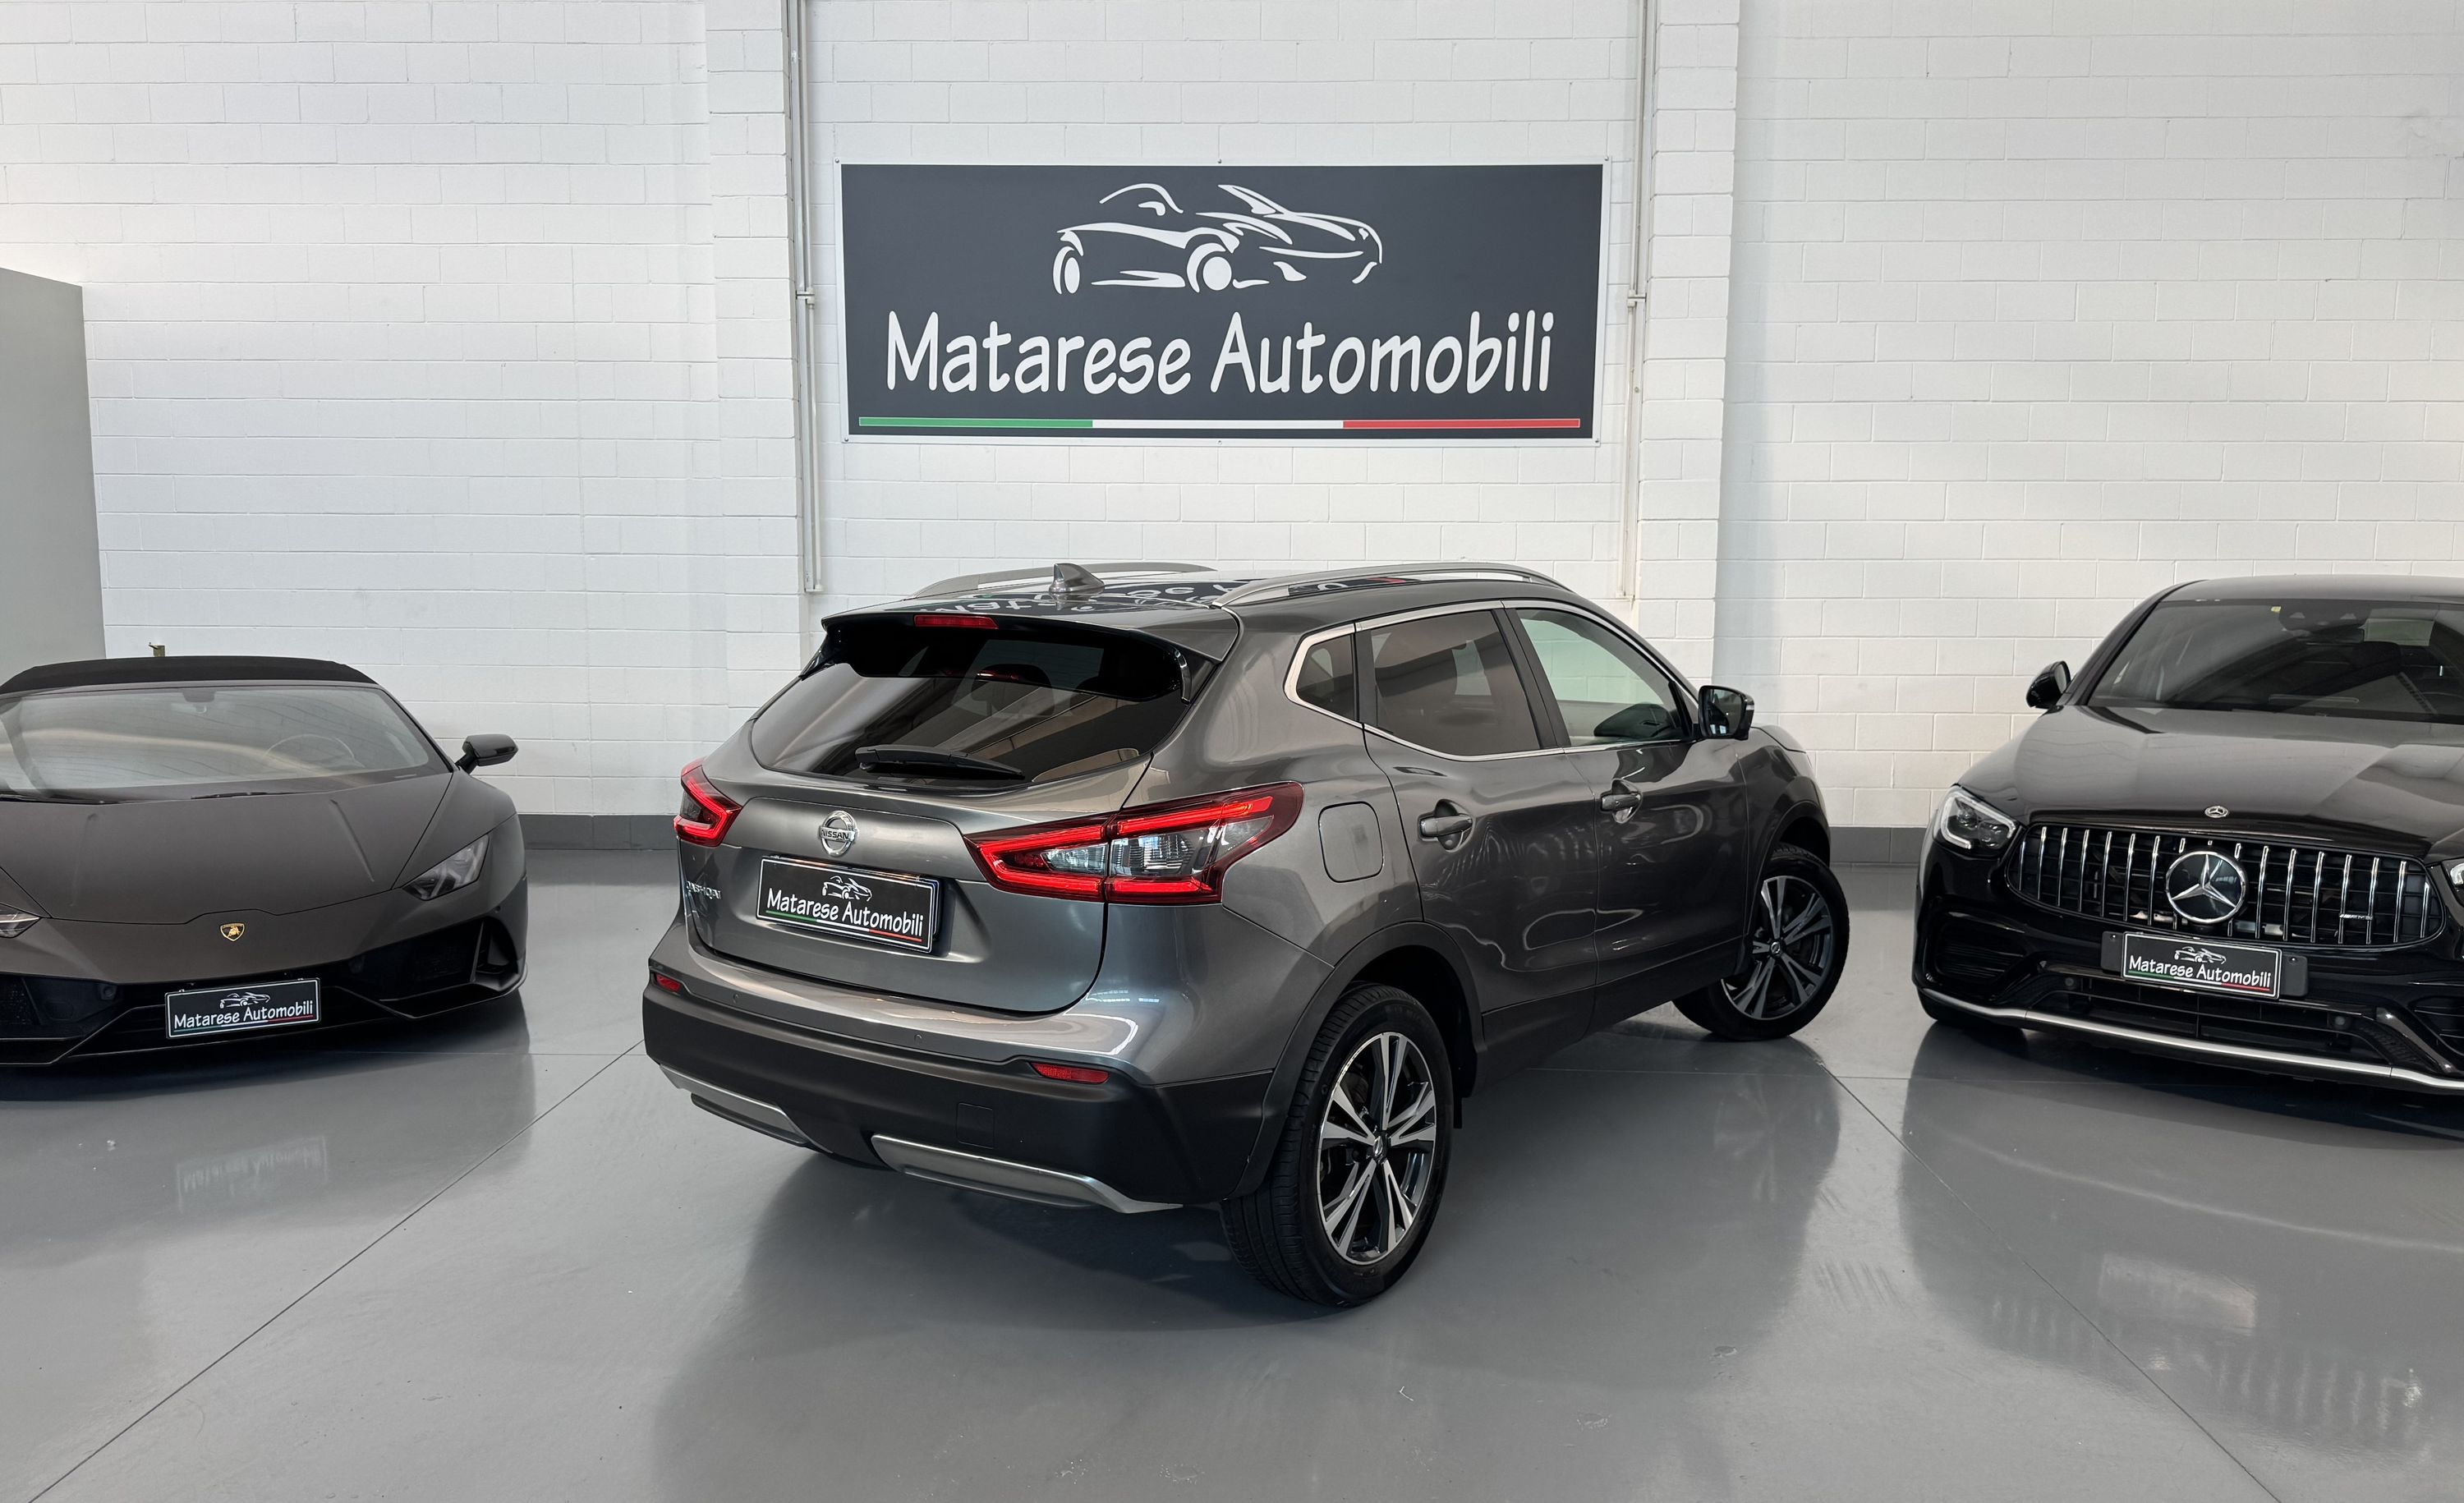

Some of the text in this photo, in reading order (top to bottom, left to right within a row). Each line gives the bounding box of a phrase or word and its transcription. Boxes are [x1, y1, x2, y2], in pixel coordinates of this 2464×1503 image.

[887, 310, 1554, 395] Matarese Automobili
[821, 829, 849, 839] NISSAN
[767, 888, 924, 937] Matarese Automobili
[2129, 955, 2272, 988] Matarese Automobili
[174, 1000, 314, 1029] Matarese Automobili
